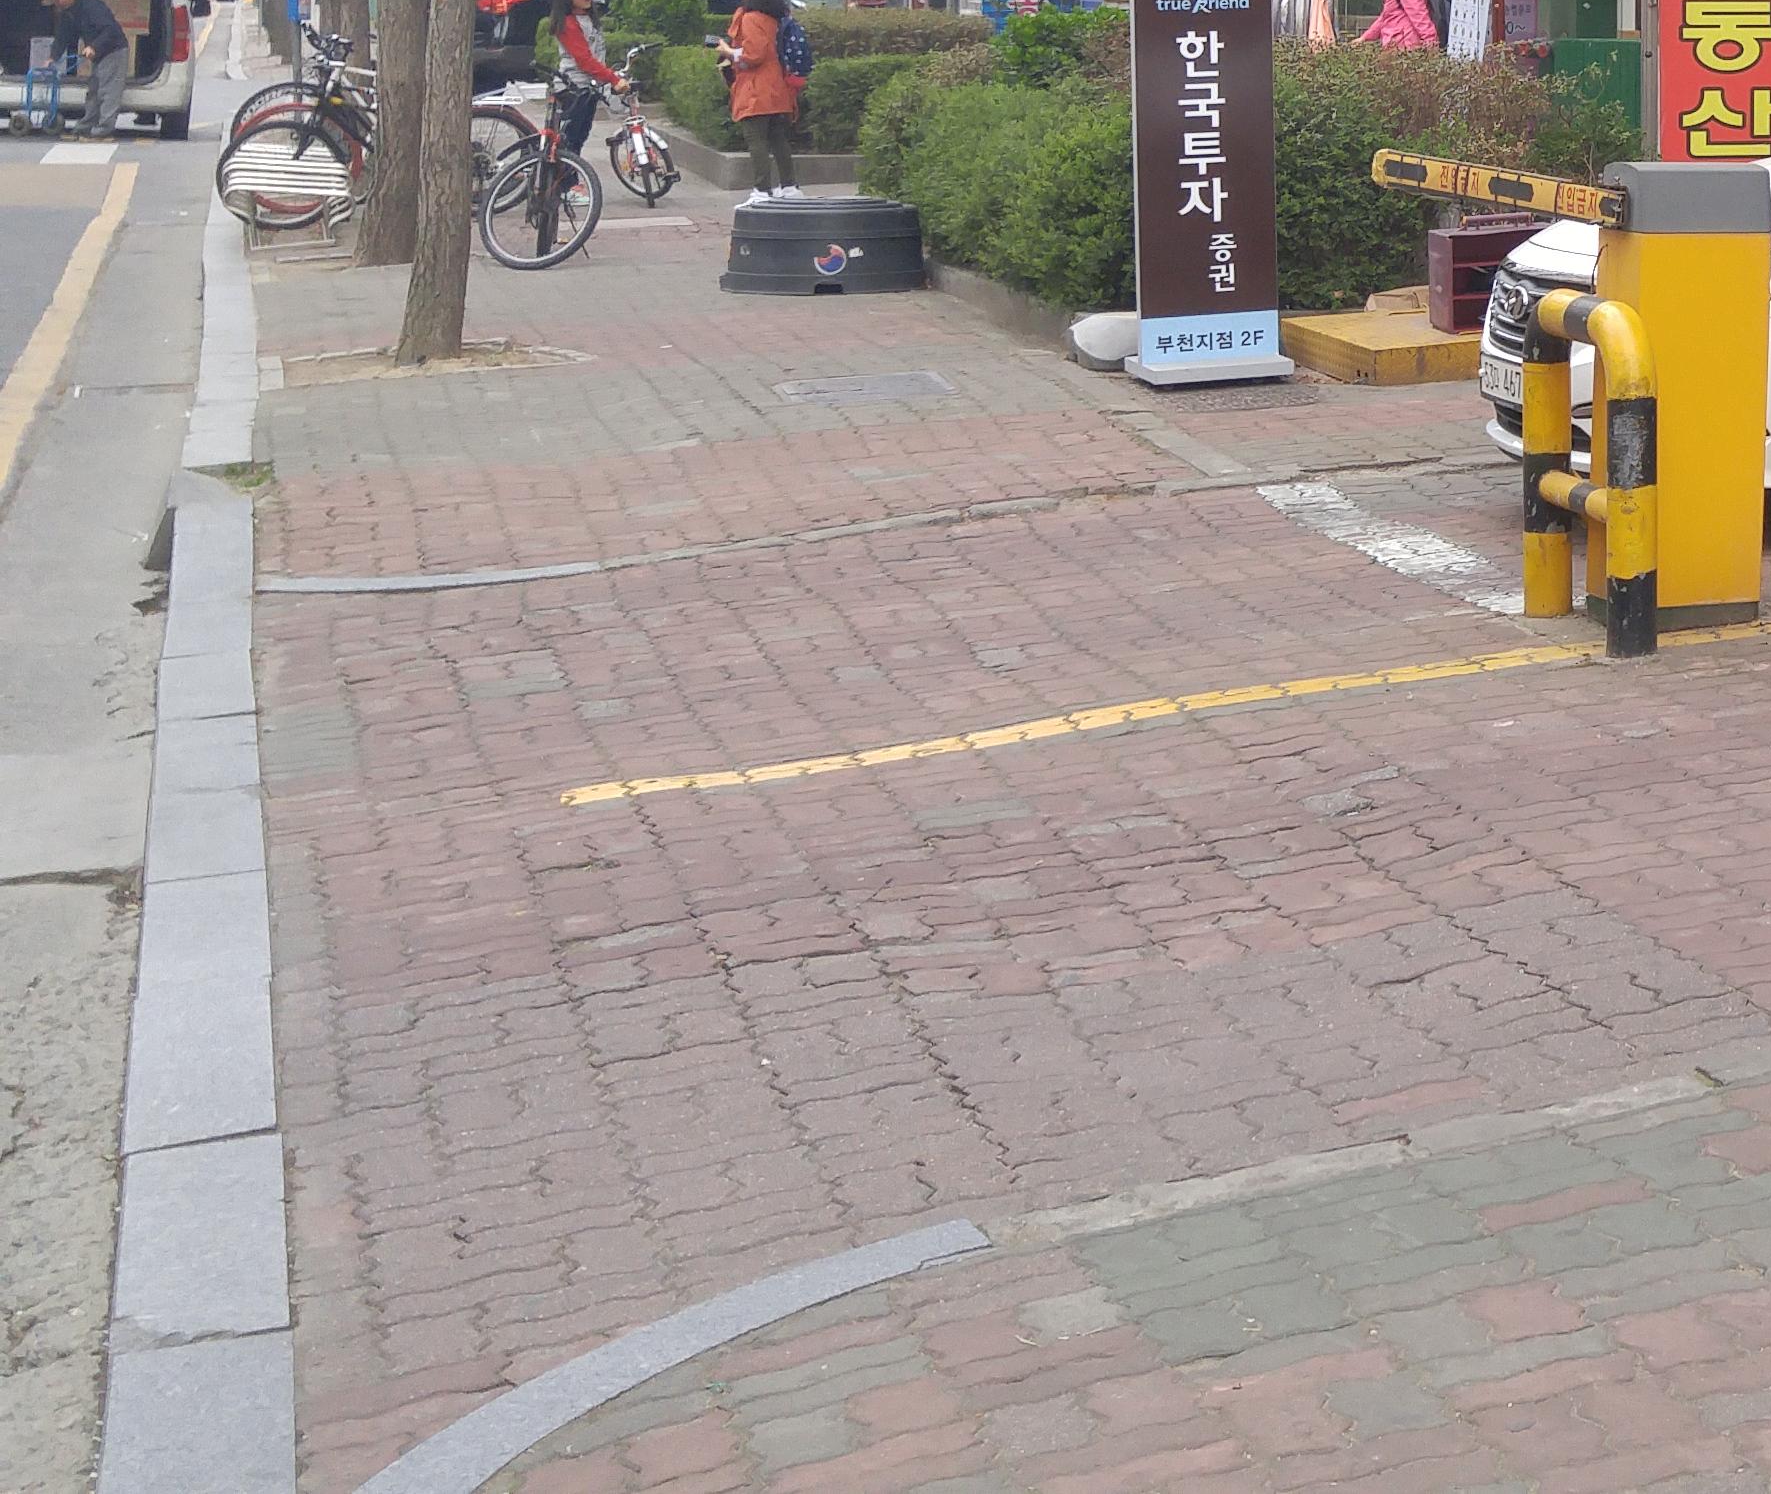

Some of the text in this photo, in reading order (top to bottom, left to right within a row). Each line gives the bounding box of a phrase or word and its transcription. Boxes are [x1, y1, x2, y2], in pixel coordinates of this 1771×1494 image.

[1176, 30, 1238, 292] 한국투자 증권
[1155, 329, 1265, 354] 부천지점 2F
